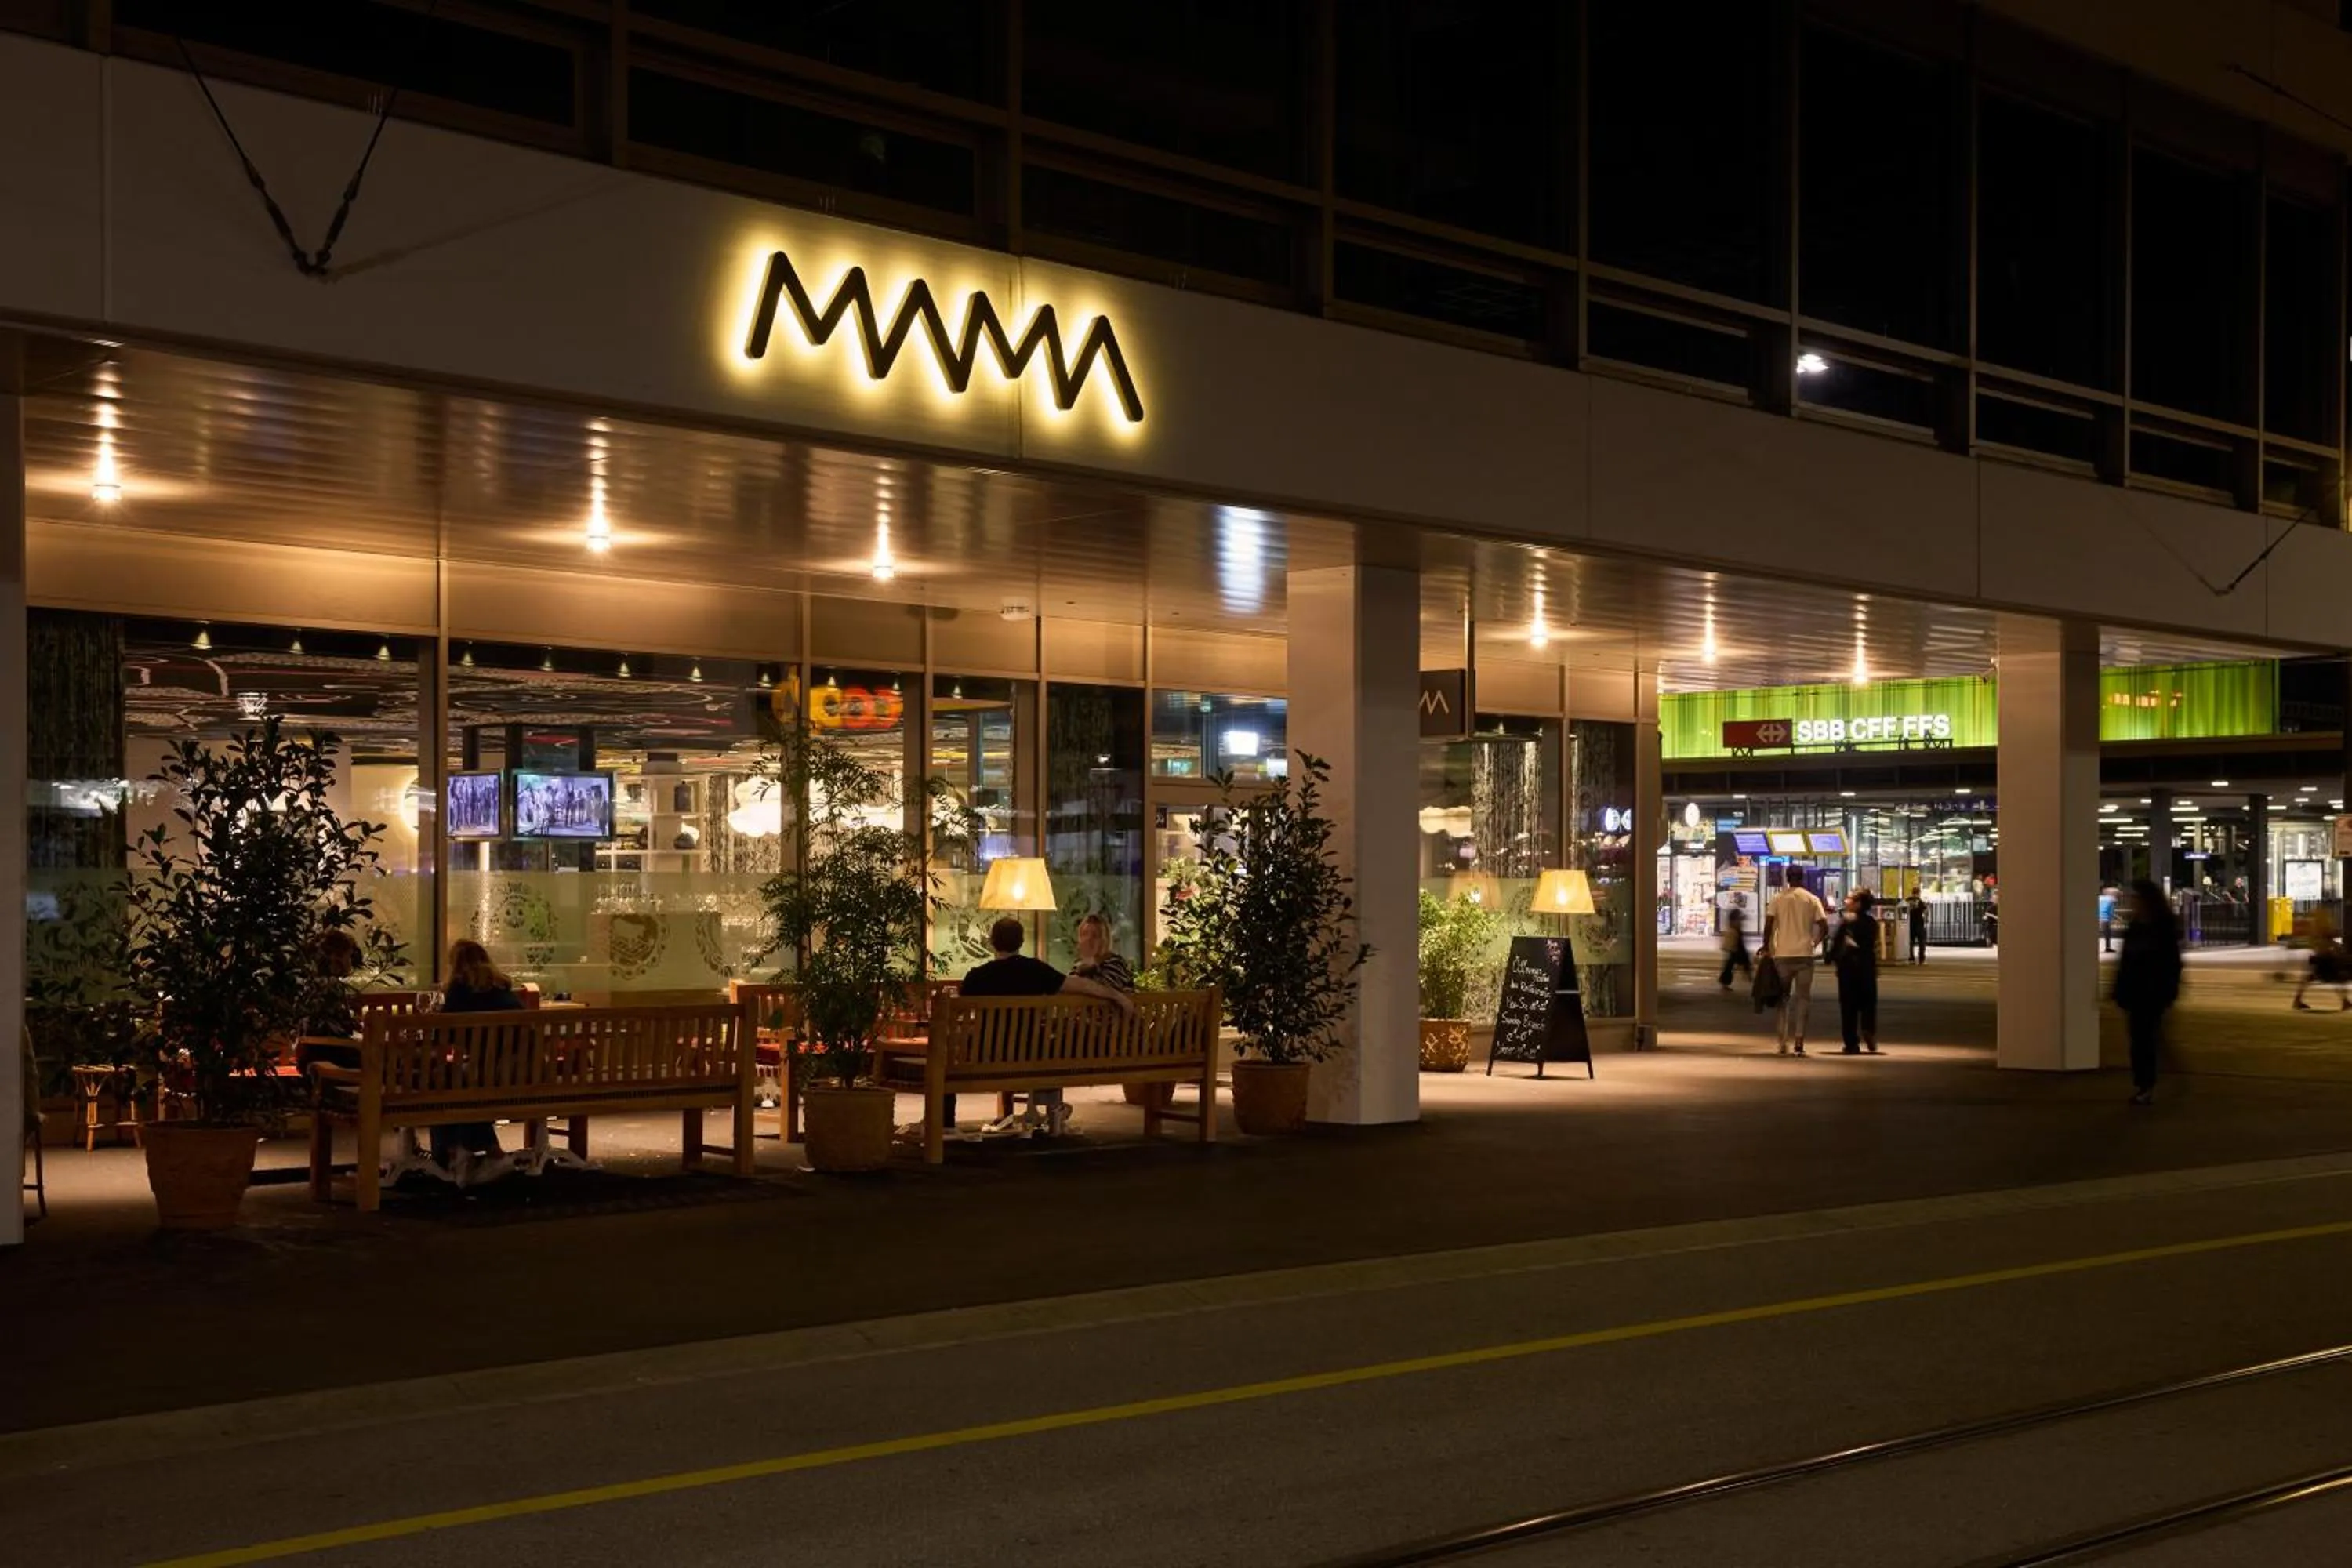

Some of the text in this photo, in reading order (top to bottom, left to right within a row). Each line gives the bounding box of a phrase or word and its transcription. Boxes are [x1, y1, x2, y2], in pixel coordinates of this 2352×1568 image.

[1798, 713, 1951, 742] SBB CFF FFS
